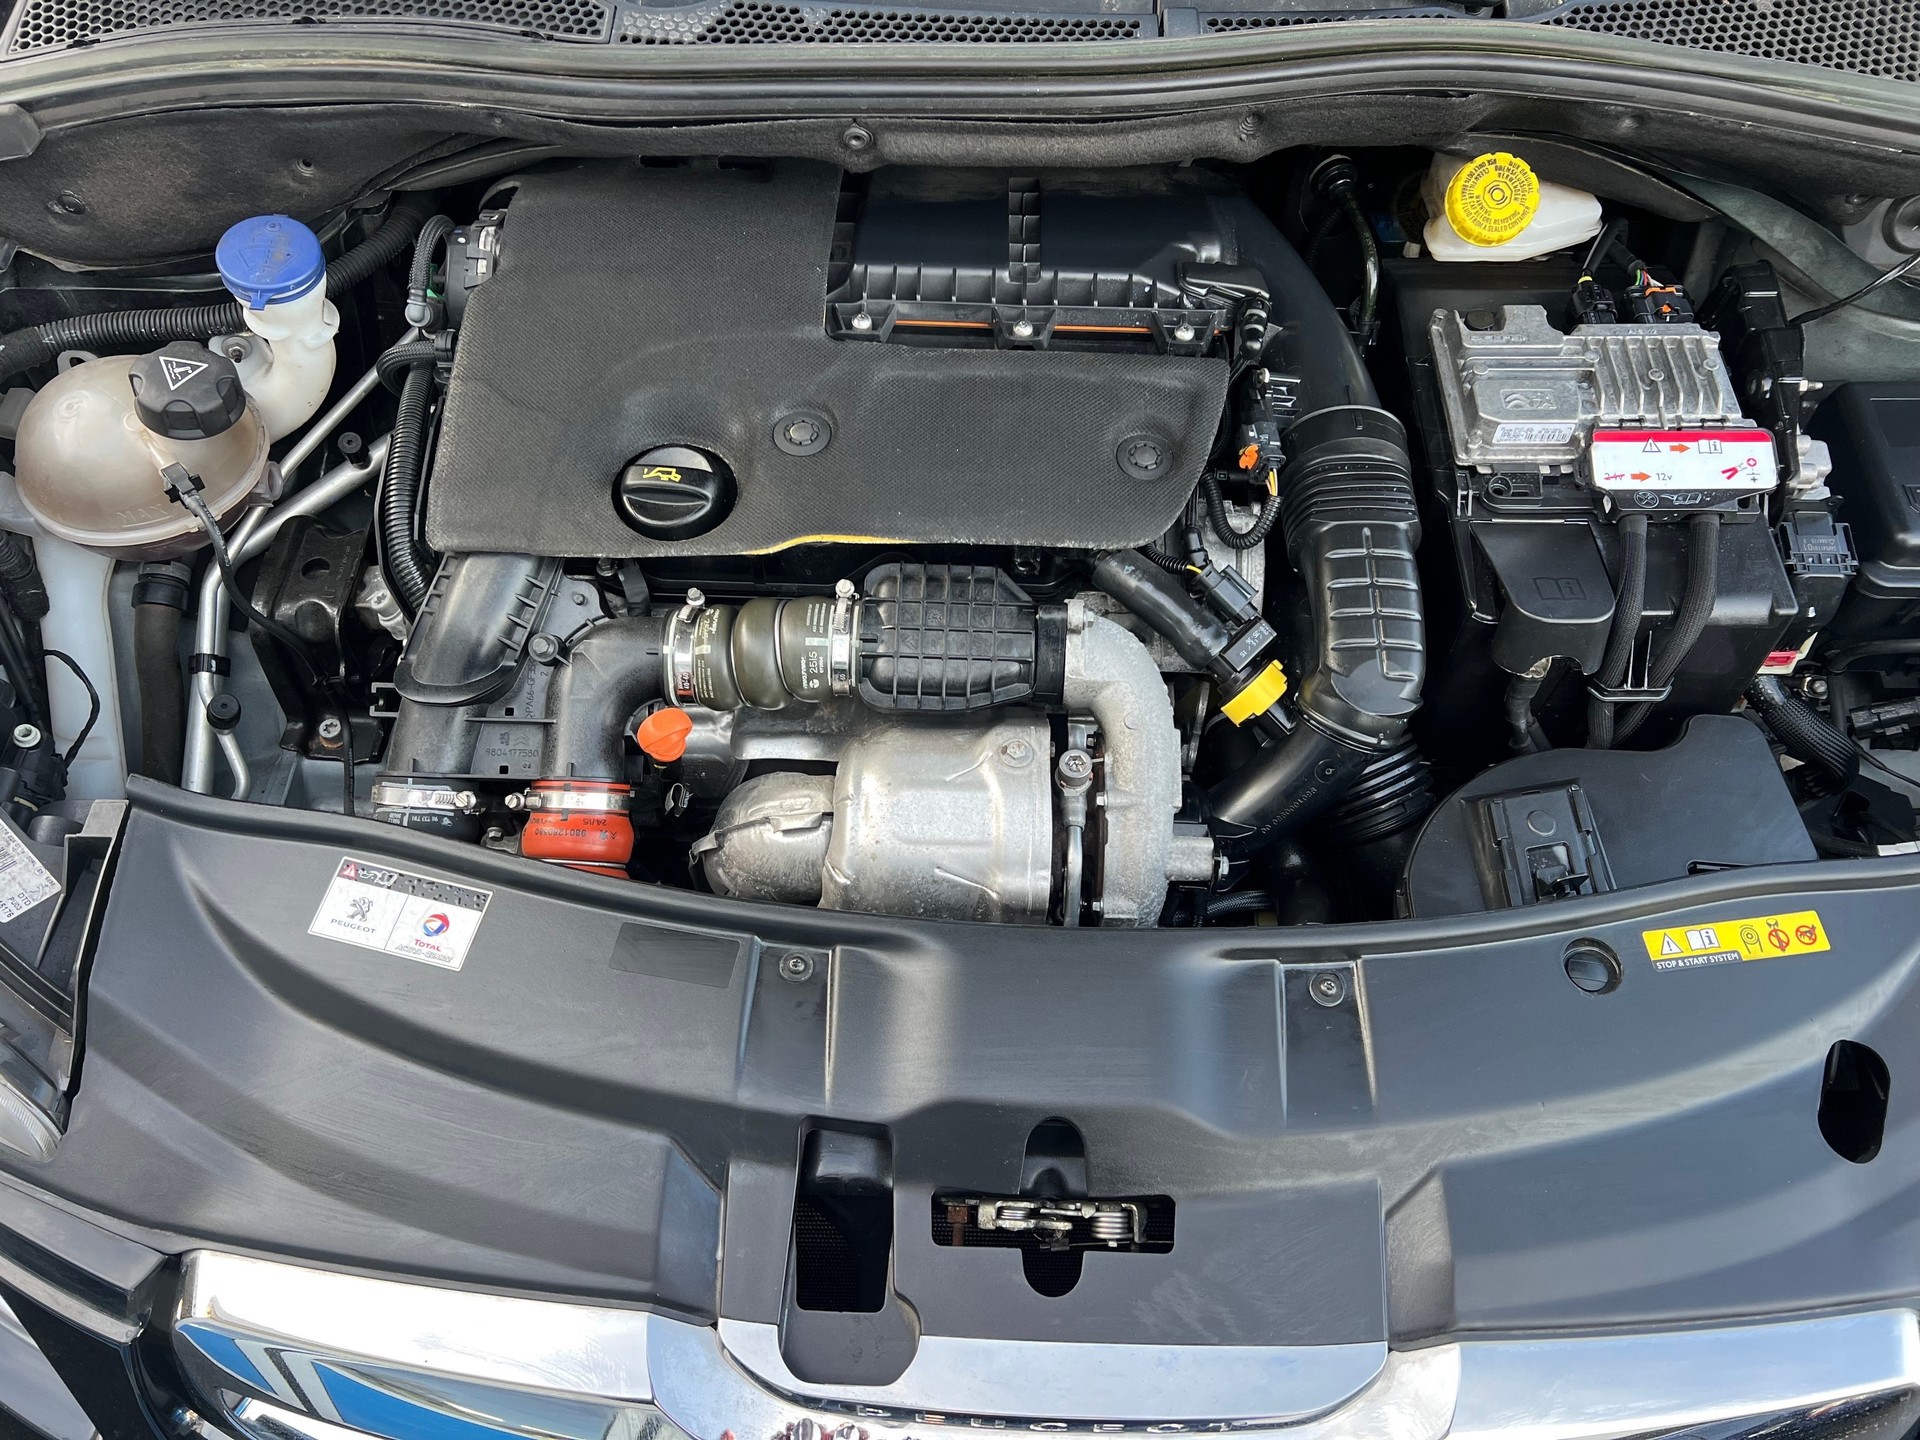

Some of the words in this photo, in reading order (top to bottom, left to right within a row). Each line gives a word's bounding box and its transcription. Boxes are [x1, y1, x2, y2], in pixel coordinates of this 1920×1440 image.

[1474, 167, 1490, 183] CLEAN
[1508, 160, 1520, 170] NUR
[1519, 168, 1534, 194] ORIGINAL
[1468, 200, 1477, 212] CAP
[1471, 215, 1484, 228] FROM
[1487, 224, 1508, 232] SEALED
[1508, 205, 1531, 230] CONTAINER
[1473, 210, 1492, 225] BEFORE
[1493, 210, 1521, 225] REMOVING
[1656, 472, 1673, 481] 12v
[330, 918, 377, 934] PEUGEOT
[414, 938, 442, 952] TOTAL
[1656, 961, 1677, 969] STOP
[1684, 956, 1708, 966] START
[1709, 952, 1739, 963] SYSTEM
